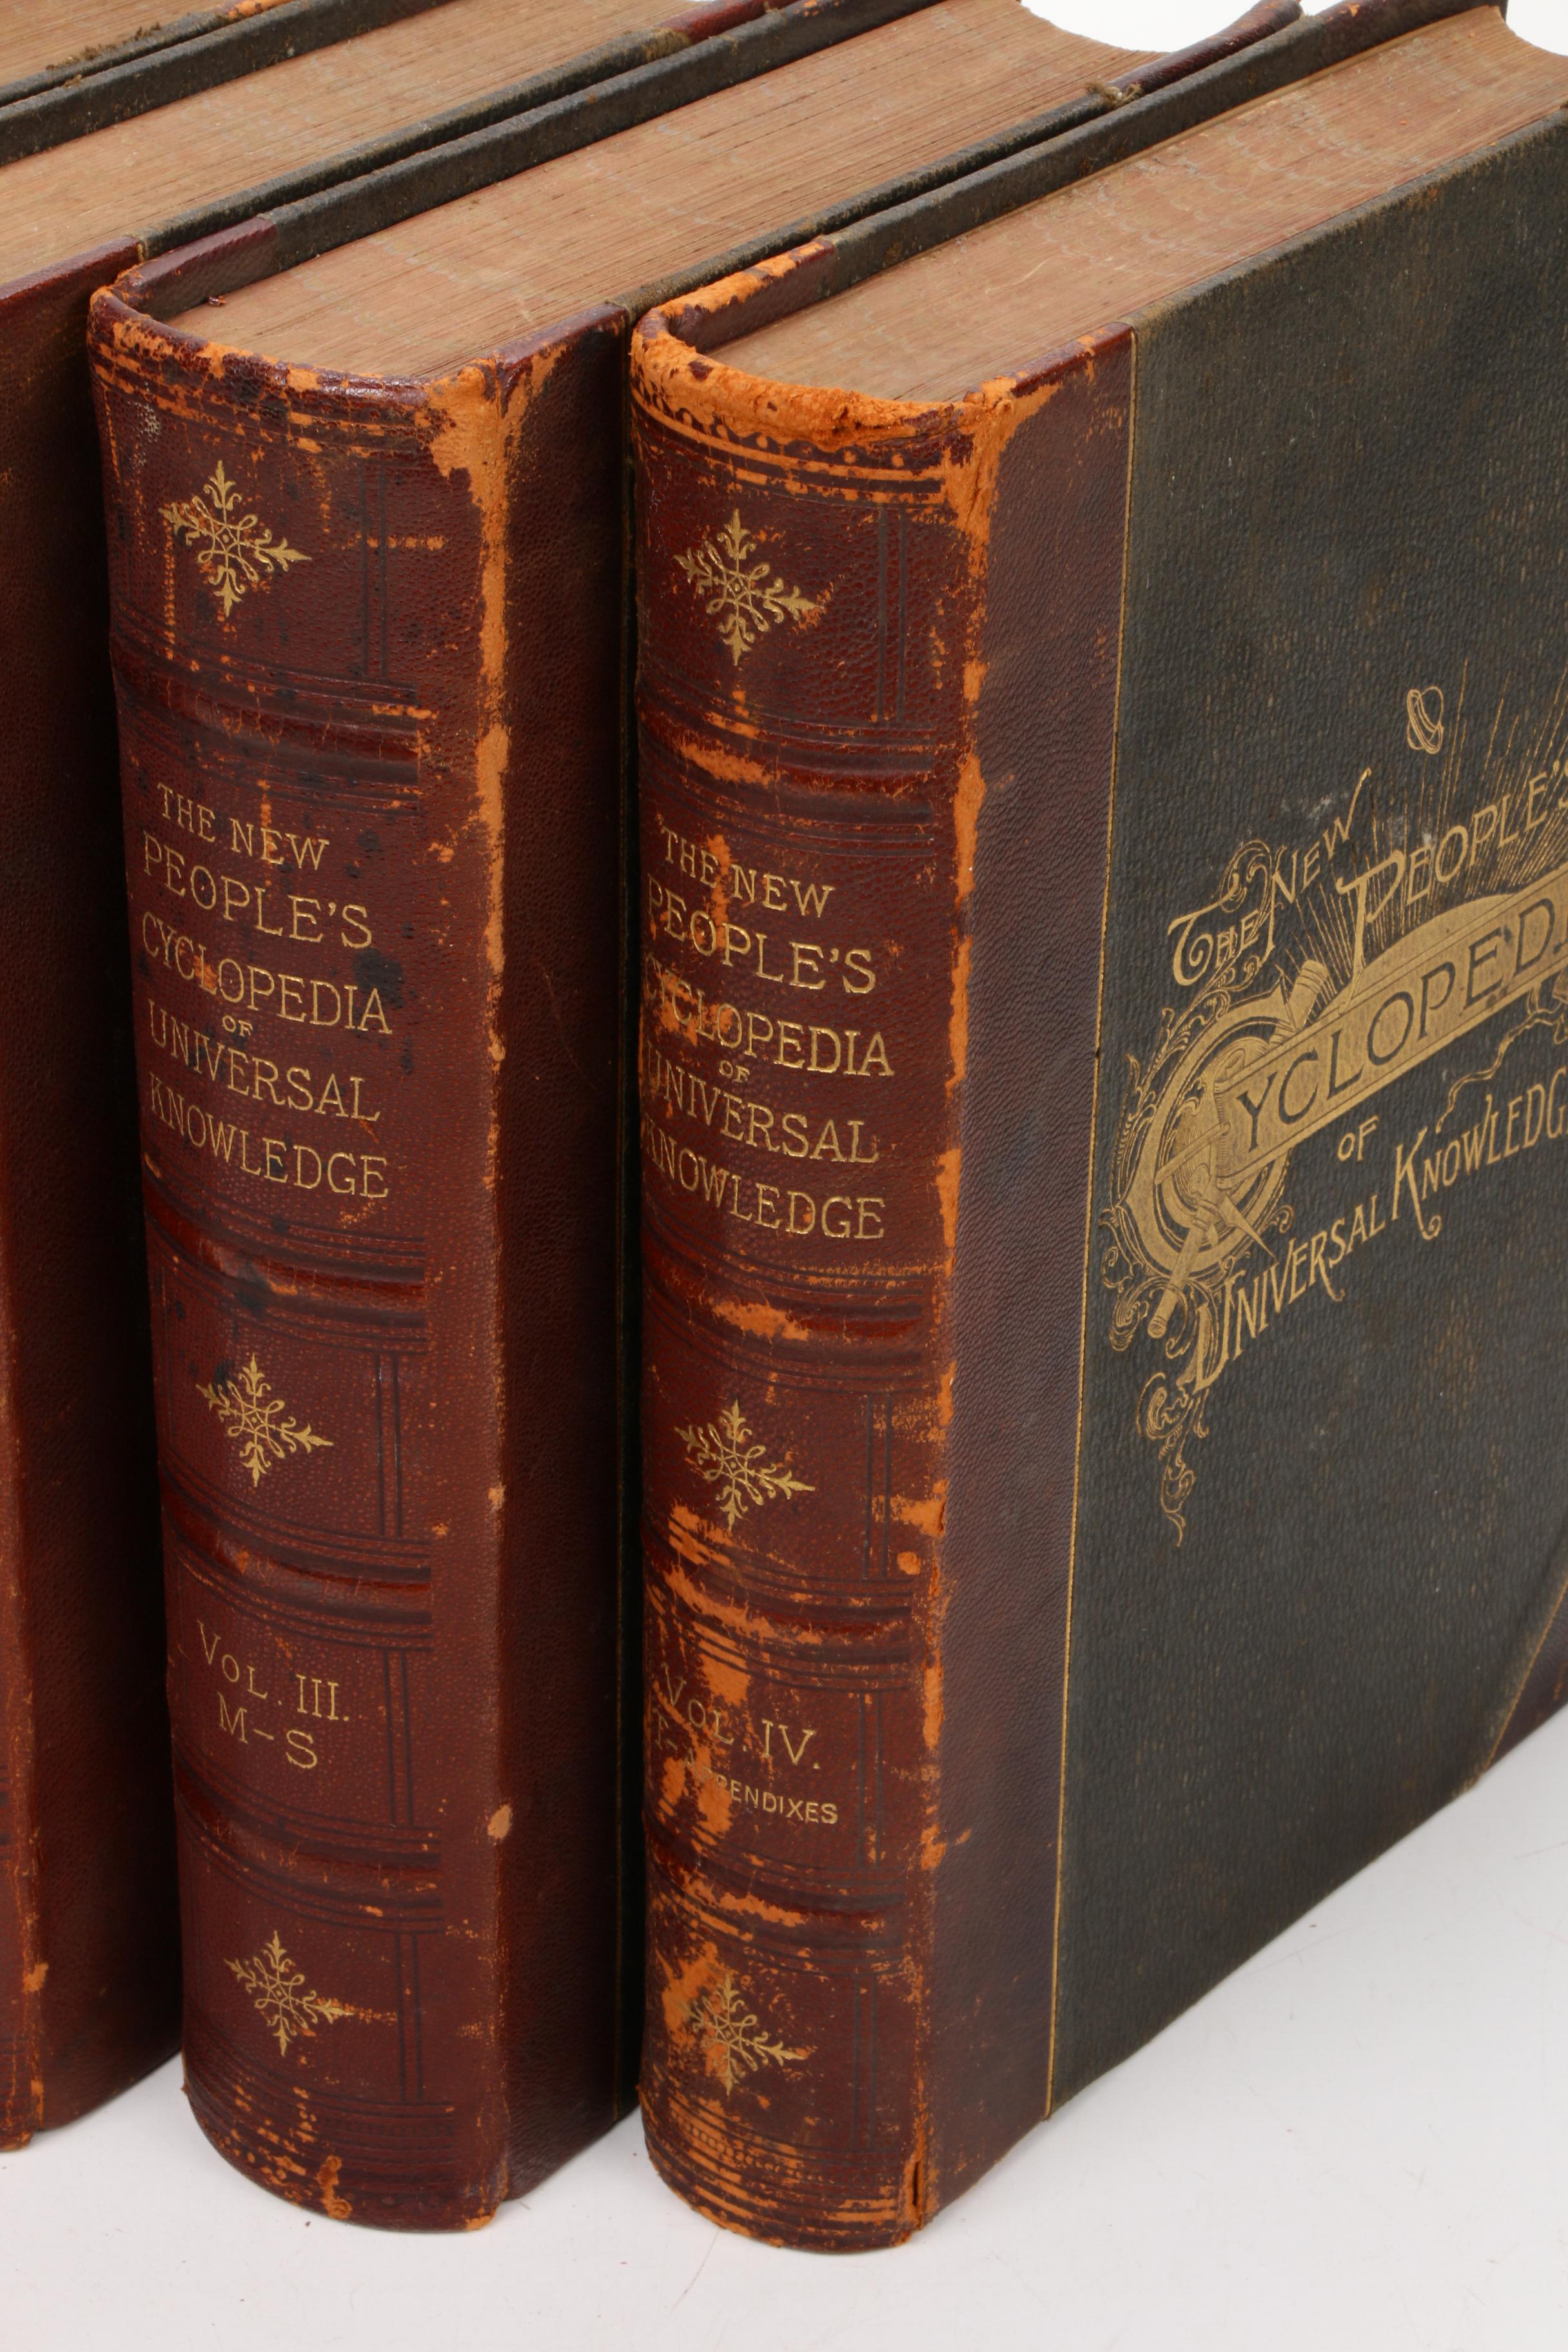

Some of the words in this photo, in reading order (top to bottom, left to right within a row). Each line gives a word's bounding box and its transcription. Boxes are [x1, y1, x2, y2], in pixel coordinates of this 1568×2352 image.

[157, 782, 217, 842] THE
[230, 818, 330, 871] NEW
[660, 825, 721, 890] THE
[731, 863, 836, 919] NEW
[1168, 872, 1262, 986] THE
[1256, 767, 1372, 968] NEW
[142, 831, 373, 949] PEOPLE'S
[647, 873, 877, 994] PEOPLE'S
[141, 911, 393, 1035] CYCLOPEDIA
[222, 1014, 253, 1037] OF
[148, 999, 381, 1122] UNIVERSAL
[647, 1040, 879, 1163] UNIVERSAL
[719, 1059, 750, 1083] OF
[1124, 895, 1568, 1280] CYCLOPED
[148, 1071, 389, 1199] KNOWLEDGE
[644, 1112, 887, 1240] KNOWLEDGE
[1338, 1115, 1379, 1161] OF
[1193, 1195, 1386, 1391] UNIVERSAL
[1391, 1065, 1568, 1240] KNOWLEDG
[197, 1619, 282, 1707] VOL.
[295, 1673, 350, 1722] III.
[761, 1717, 821, 1770] IV.
